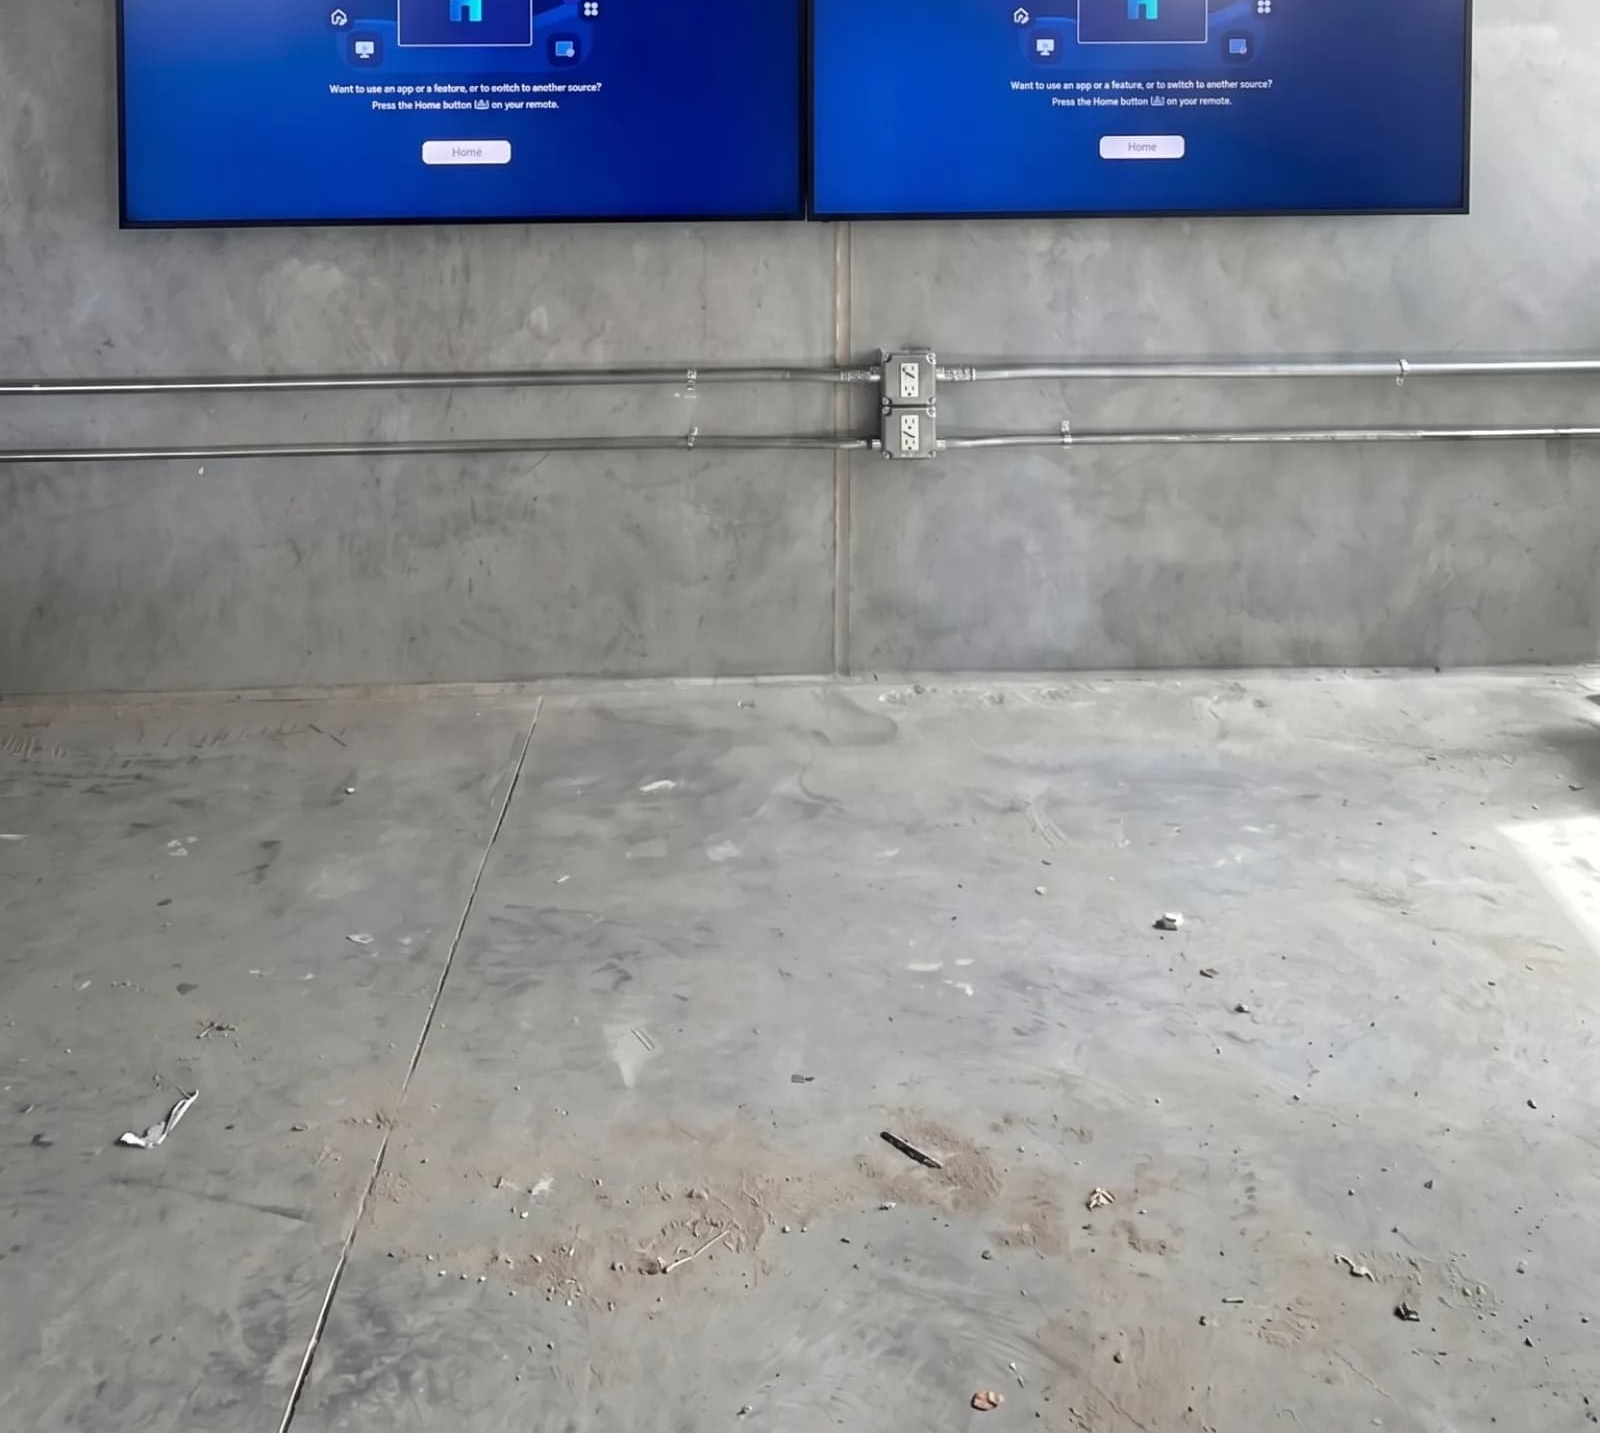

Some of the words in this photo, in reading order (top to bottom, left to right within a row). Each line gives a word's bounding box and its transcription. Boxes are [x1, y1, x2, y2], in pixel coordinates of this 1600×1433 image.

[329, 84, 353, 94] Want
[355, 85, 365, 94] to
[366, 85, 382, 94] use
[383, 85, 395, 94] an
[415, 85, 425, 93] or
[426, 85, 432, 93] a
[468, 85, 478, 93] or
[479, 83, 490, 93] to
[521, 83, 531, 93] to
[531, 82, 566, 93] another
[1010, 80, 1033, 90] Want
[1034, 81, 1044, 90] to
[1045, 82, 1061, 90] use
[1063, 82, 1074, 90] an
[1075, 82, 1092, 92] app
[1093, 82, 1102, 90] or
[1103, 82, 1109, 90] a
[1145, 82, 1154, 90] or
[1156, 80, 1165, 89] to
[1166, 80, 1194, 89] switch
[1195, 80, 1204, 89] to
[1206, 79, 1238, 89] another
[371, 100, 396, 110] Press
[397, 100, 413, 110] the
[414, 100, 441, 110] Home
[442, 100, 472, 110] button
[491, 101, 502, 109] on
[504, 101, 524, 111] your
[1051, 96, 1075, 107] Press
[1076, 96, 1091, 107] the
[1092, 96, 1118, 106] Home
[1120, 96, 1148, 106] button
[1166, 98, 1177, 106] on
[1178, 97, 1197, 108] your
[1127, 141, 1157, 151] Home
[451, 147, 482, 157] Home
